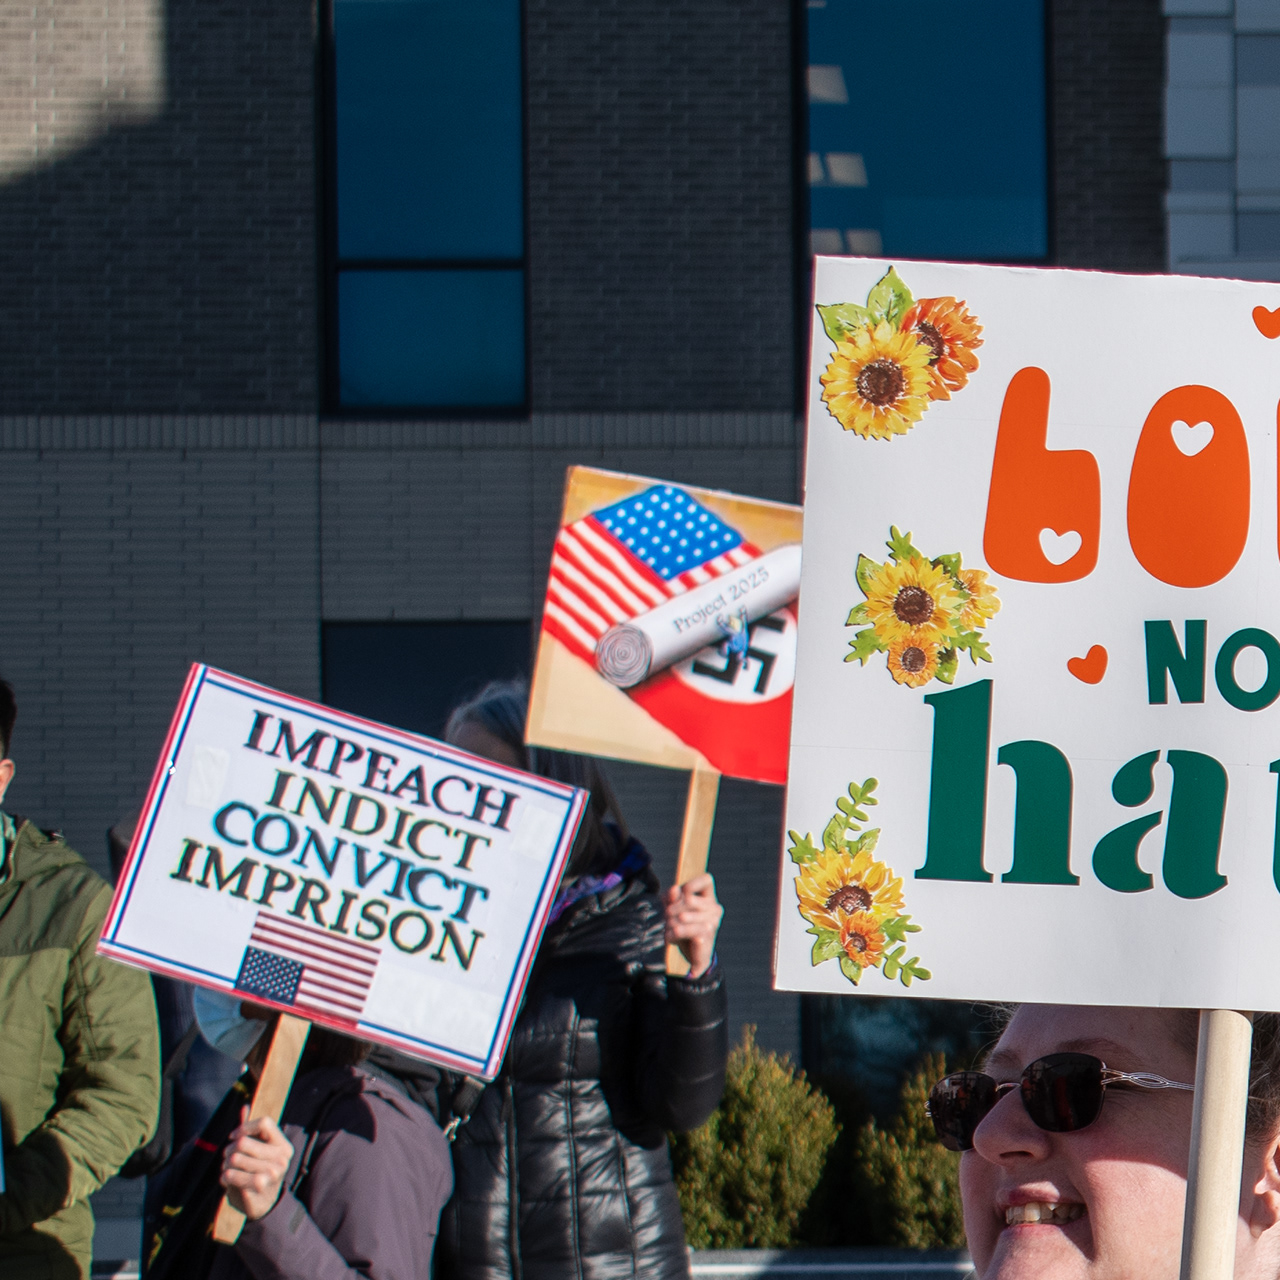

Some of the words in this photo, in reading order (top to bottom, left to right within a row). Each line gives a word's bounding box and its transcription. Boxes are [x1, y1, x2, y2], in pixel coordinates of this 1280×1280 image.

[673, 594, 728, 634] Project
[729, 565, 770, 600] 2025
[243, 709, 520, 832] IMPEACH
[265, 769, 491, 872] INDICT
[170, 837, 486, 973] IMPRISON
[212, 800, 489, 924] CONVICT
